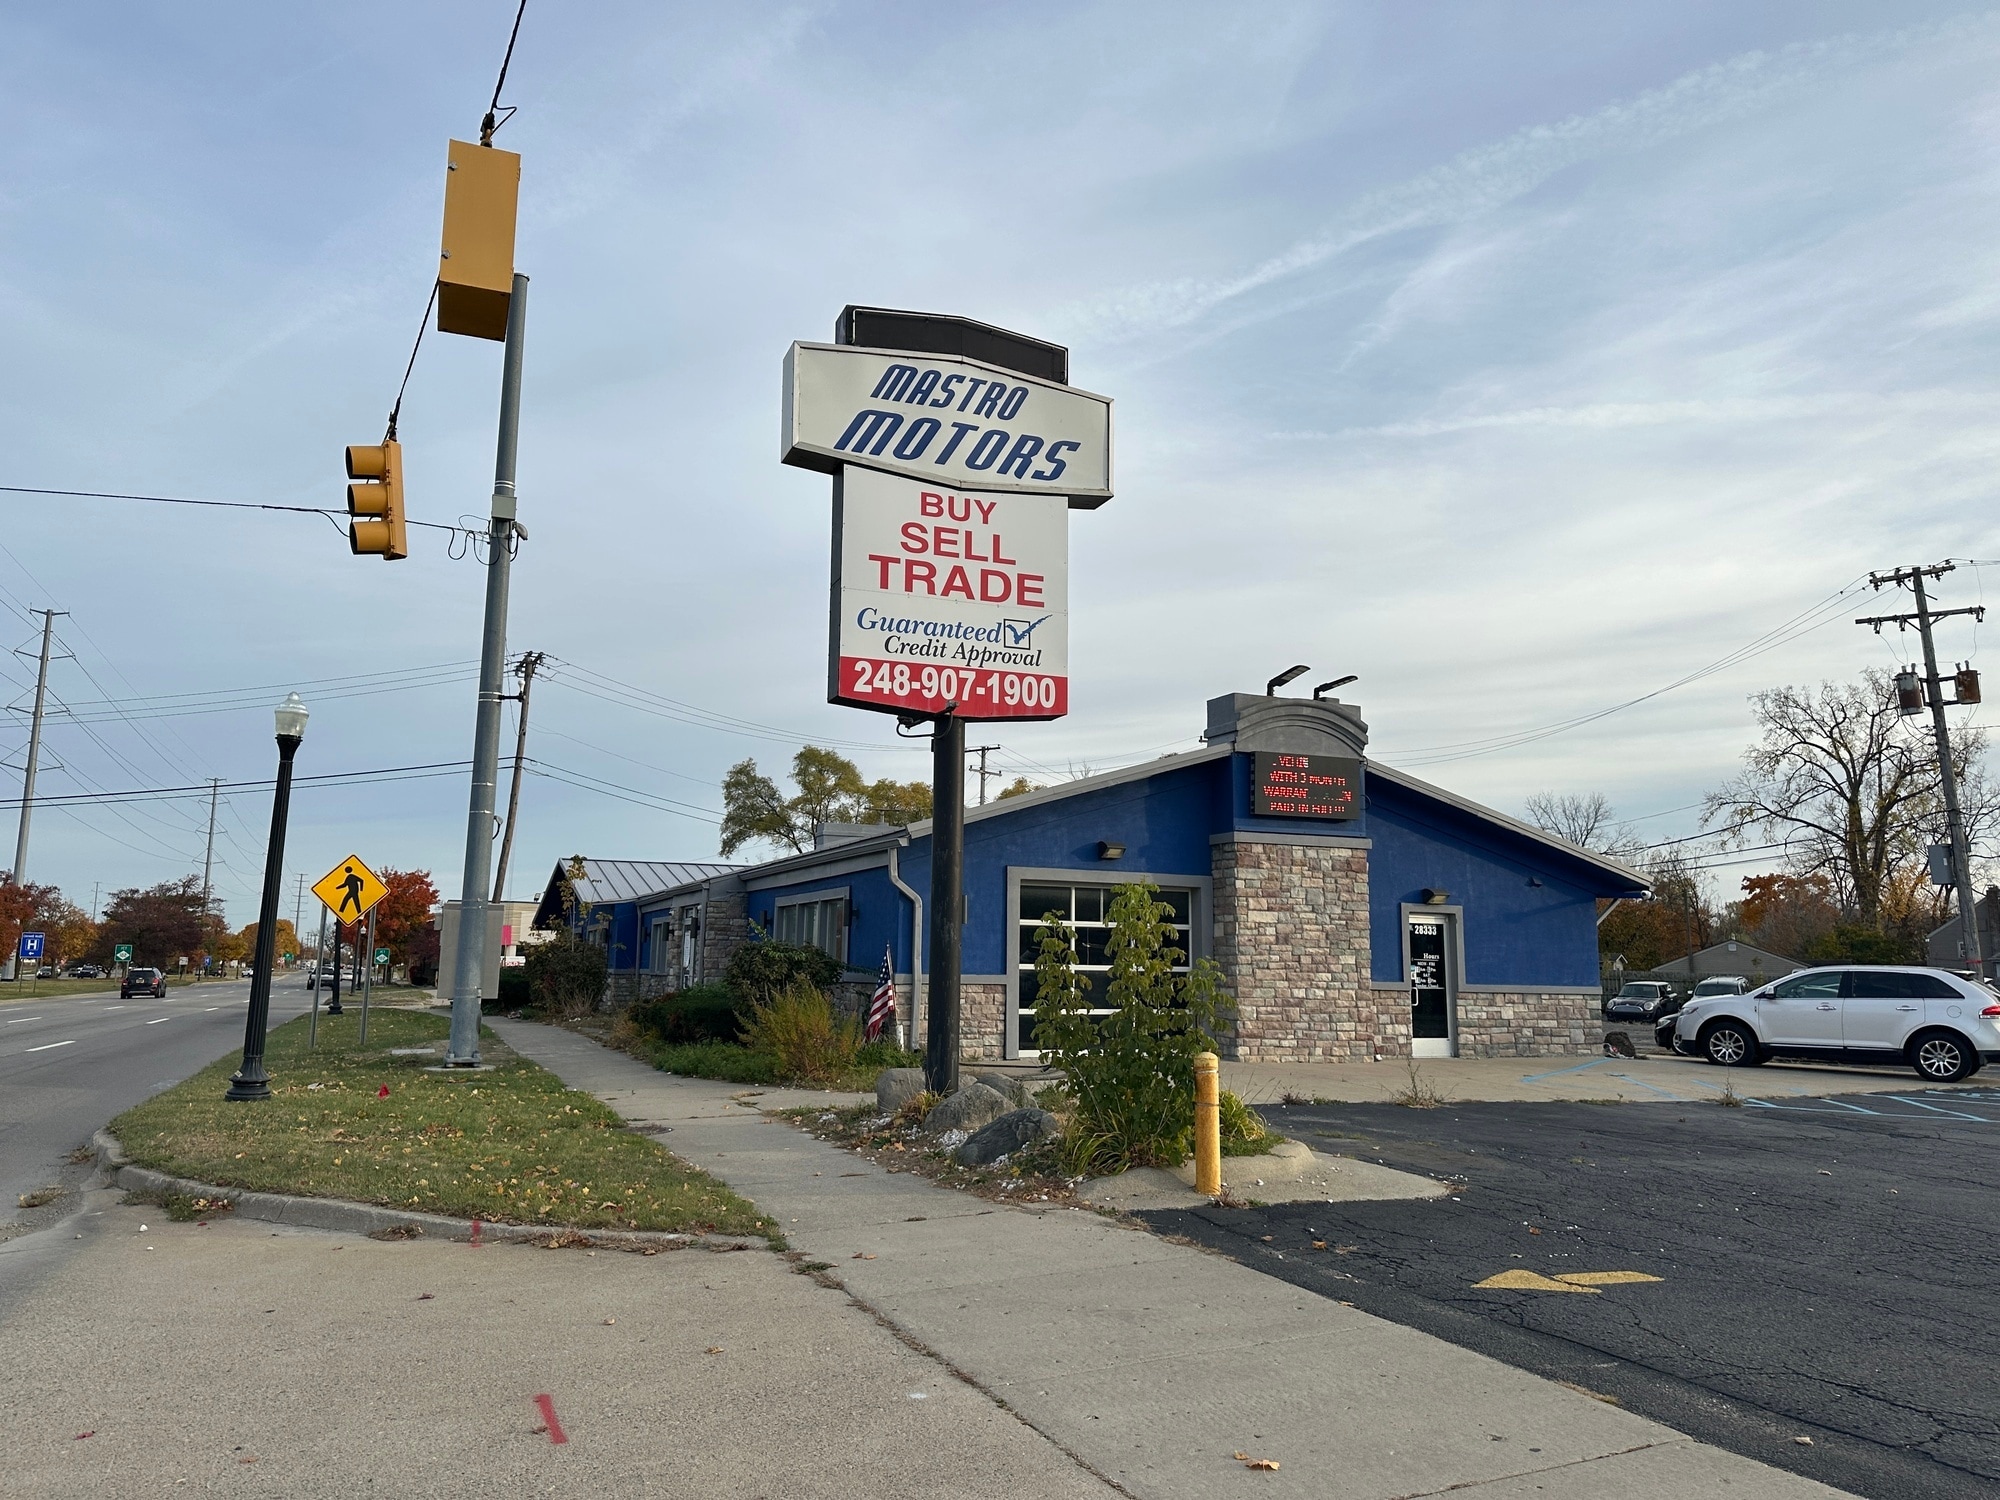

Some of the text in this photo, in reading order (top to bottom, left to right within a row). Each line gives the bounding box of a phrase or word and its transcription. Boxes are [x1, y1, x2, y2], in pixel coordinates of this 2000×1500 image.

[870, 363, 1029, 421] MASTRO
[833, 409, 1081, 481] MOTORS
[920, 491, 997, 524] BUY
[900, 521, 1016, 565] SELL
[868, 554, 1045, 608] TRADE
[857, 607, 1003, 644] Guaranteed
[884, 635, 1042, 668] Credit Approval
[853, 660, 1056, 708] 248-907-1900
[27, 939, 38, 950] H
[1414, 924, 1437, 936] 28333
